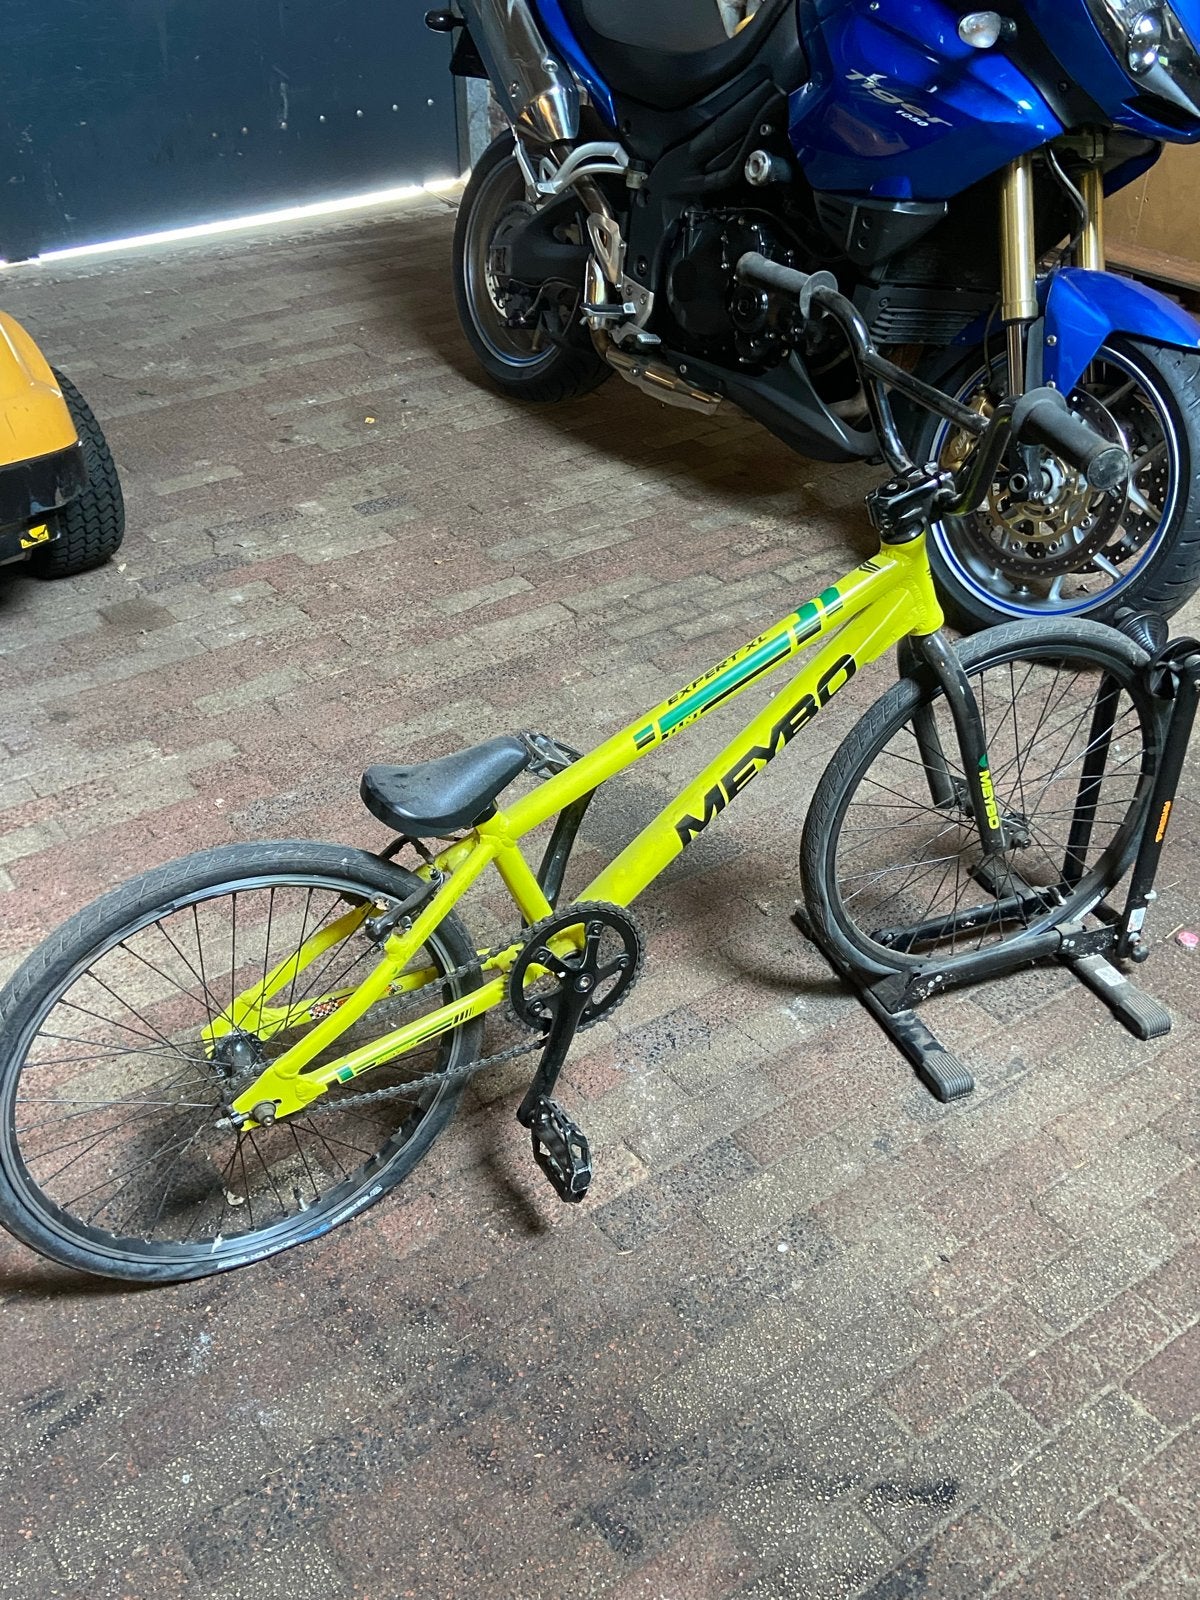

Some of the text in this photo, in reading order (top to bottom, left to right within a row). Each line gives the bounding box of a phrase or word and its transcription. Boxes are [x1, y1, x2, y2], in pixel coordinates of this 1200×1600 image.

[845, 68, 953, 127] Tiger
[895, 109, 929, 127] 1050
[667, 634, 768, 705] EXPERT XL
[674, 653, 857, 848] MEYBO
[978, 769, 1000, 830] MEYBO
